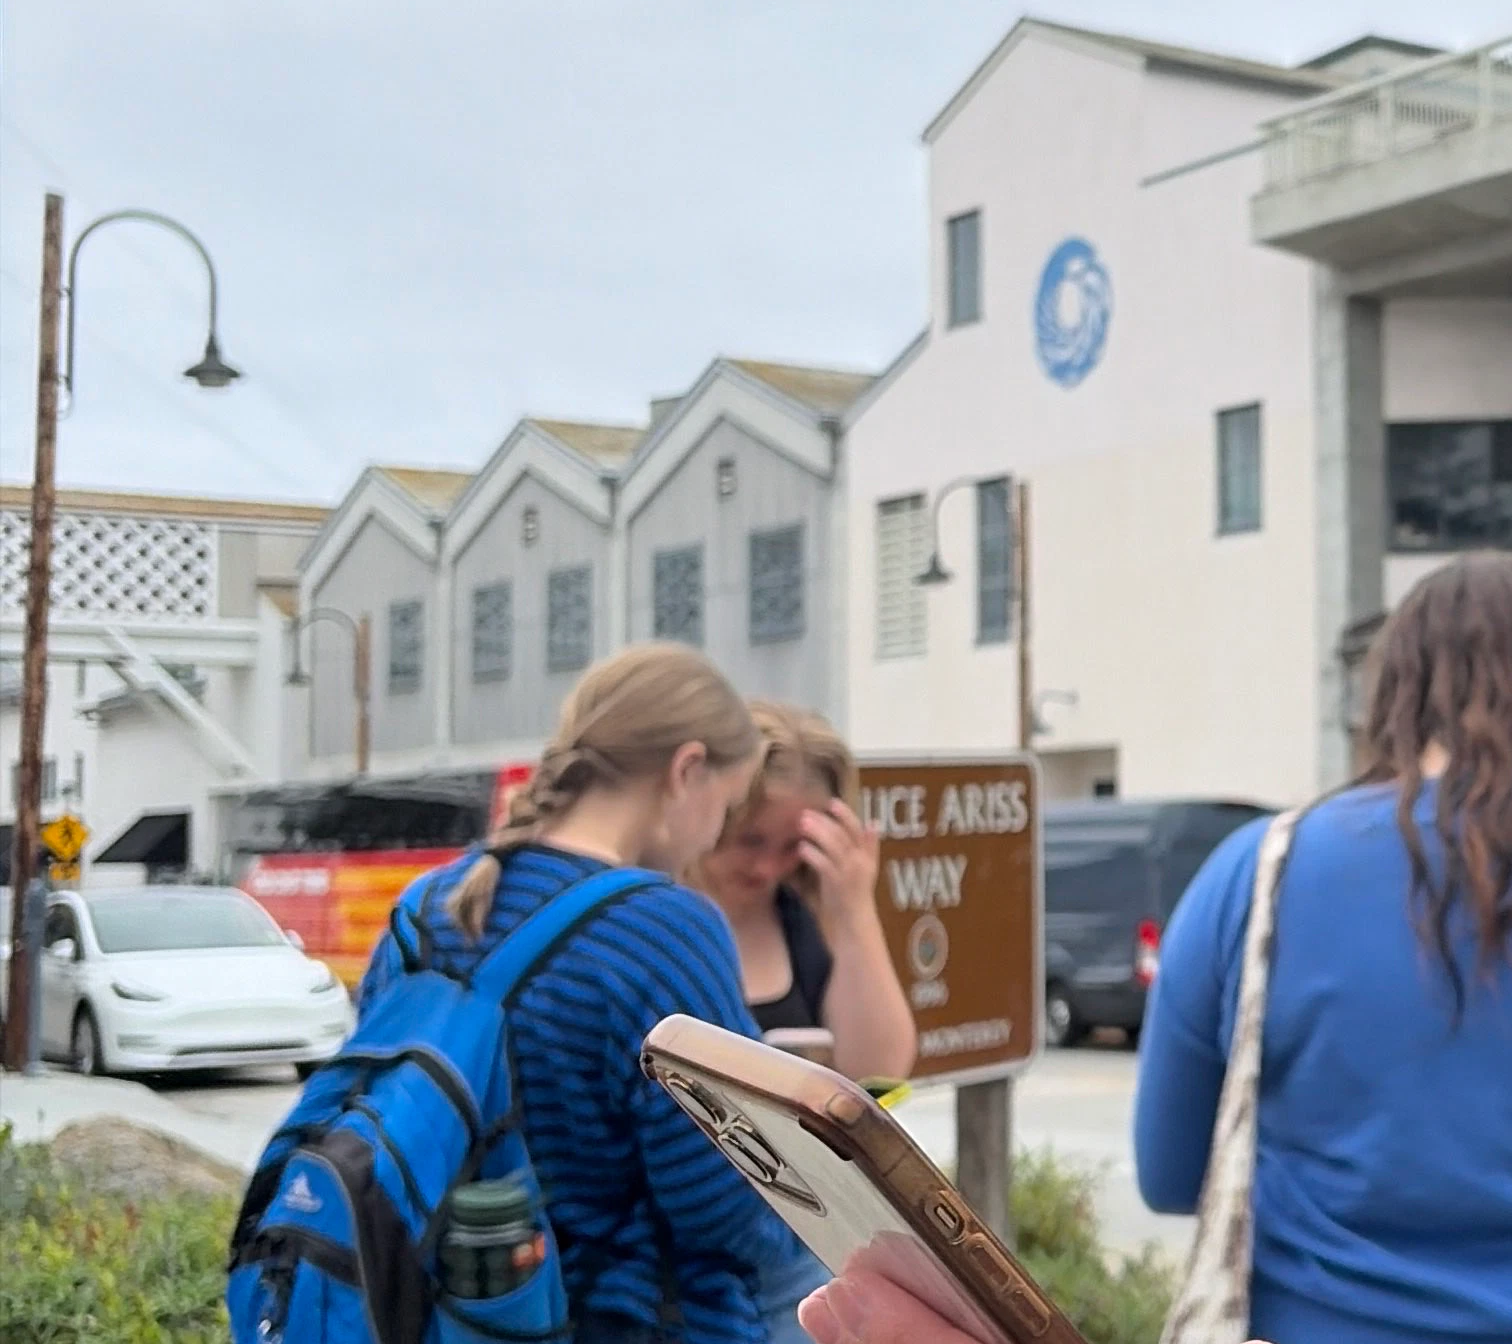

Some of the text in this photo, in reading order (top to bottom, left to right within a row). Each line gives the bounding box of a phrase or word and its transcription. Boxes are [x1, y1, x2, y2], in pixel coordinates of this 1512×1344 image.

[861, 780, 1028, 839] LICE ARISS
[886, 854, 967, 911] WAY
